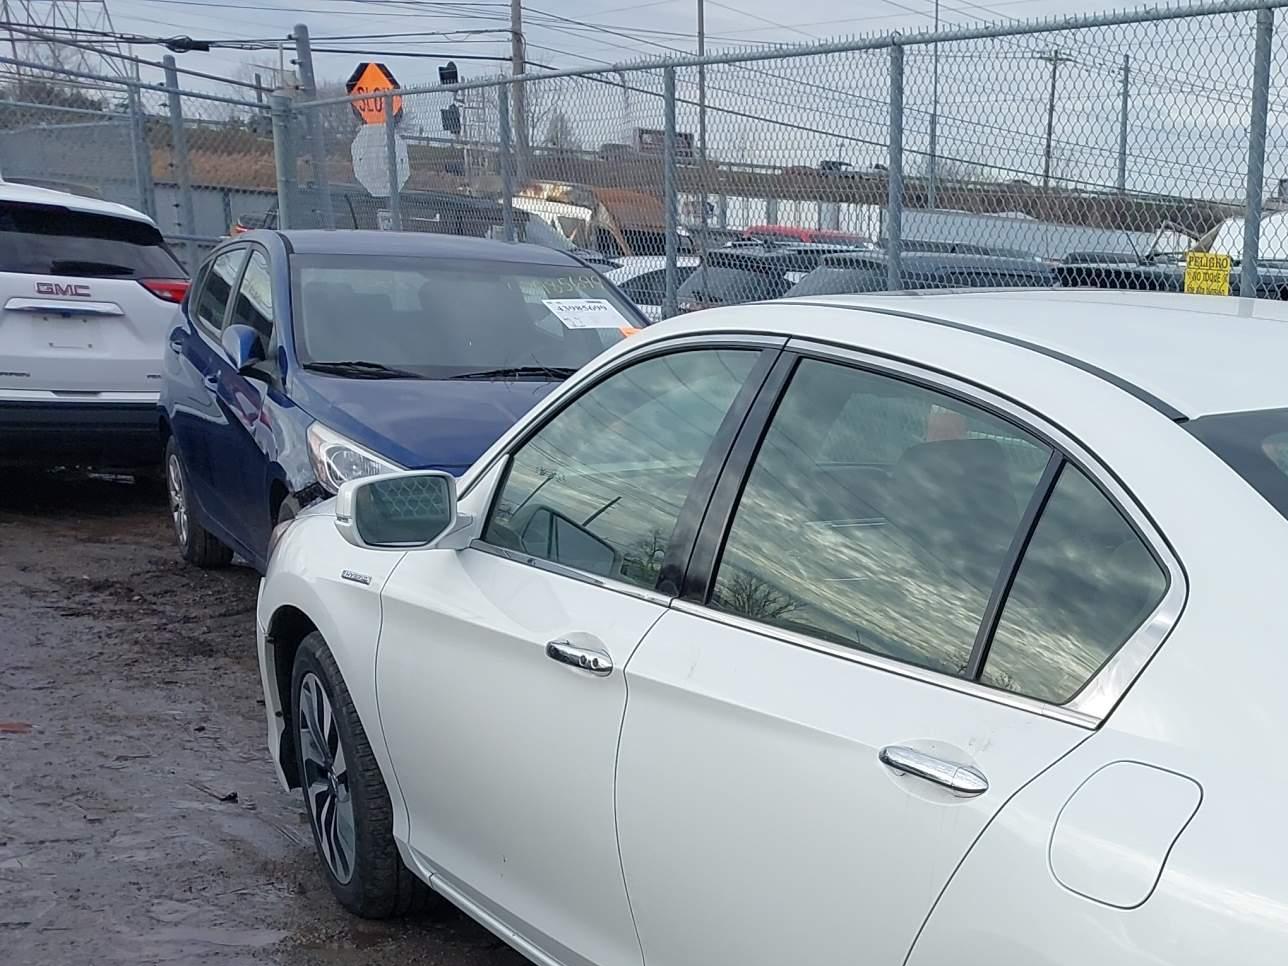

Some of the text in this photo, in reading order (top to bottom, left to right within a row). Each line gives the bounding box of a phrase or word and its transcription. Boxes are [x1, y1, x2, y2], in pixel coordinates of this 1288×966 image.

[357, 86, 393, 112] SLO
[1189, 256, 1228, 269] PELIGRO
[36, 282, 91, 297] GMC
